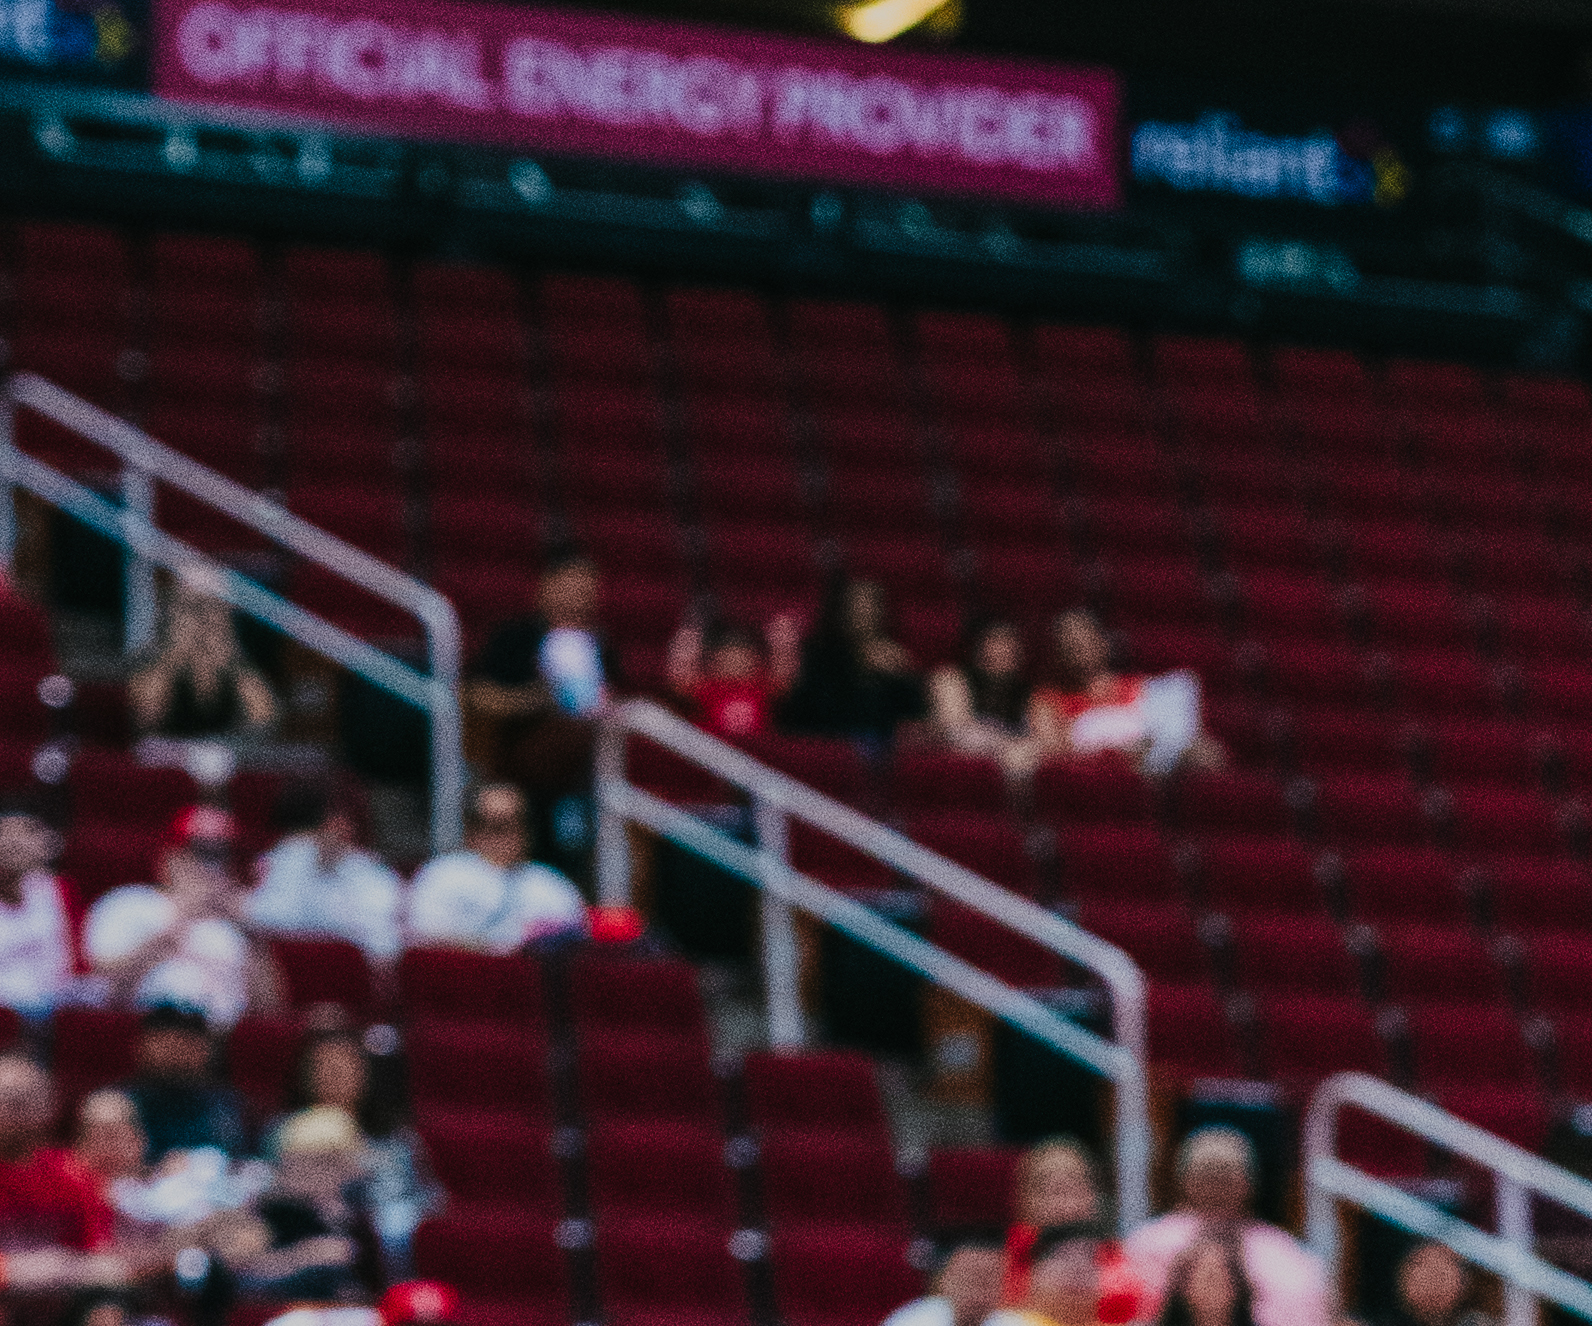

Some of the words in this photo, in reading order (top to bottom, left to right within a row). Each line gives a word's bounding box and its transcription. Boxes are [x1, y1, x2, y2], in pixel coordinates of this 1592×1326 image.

[177, 1, 494, 113] OFFICIAL
[502, 35, 763, 137] ENERGY
[772, 64, 1097, 172] PROVIDER
[1131, 107, 1340, 206] reliant
